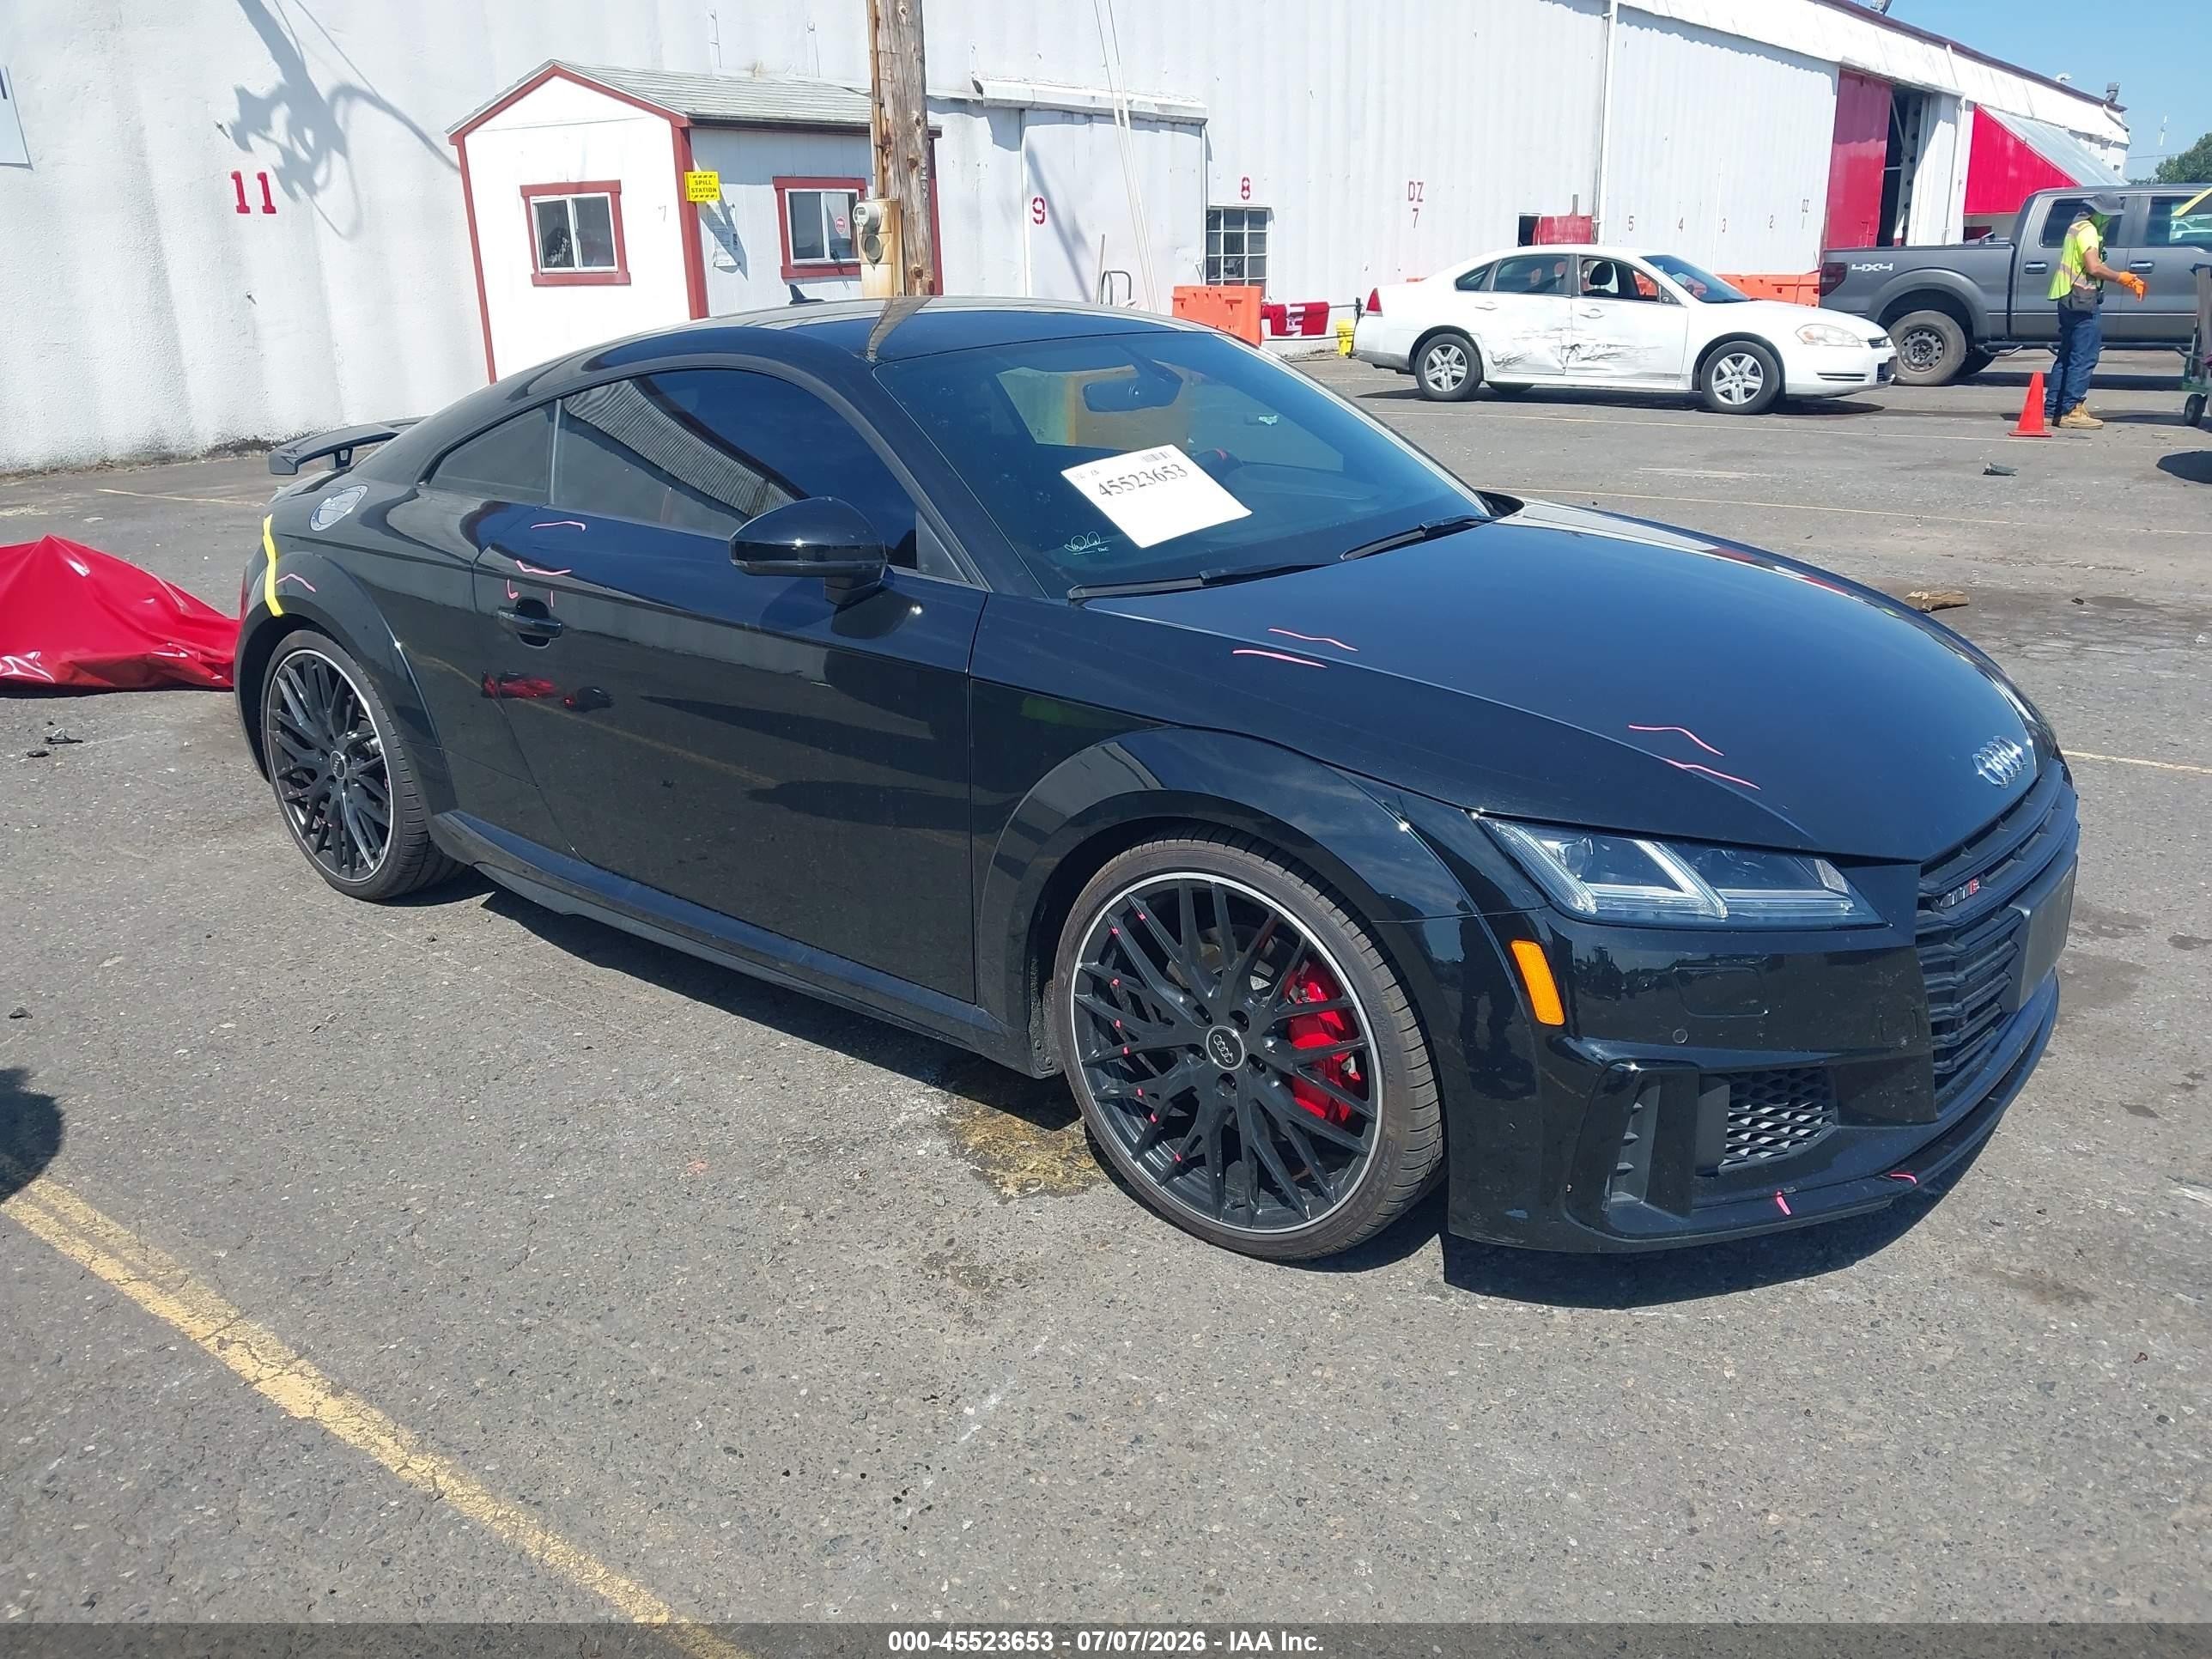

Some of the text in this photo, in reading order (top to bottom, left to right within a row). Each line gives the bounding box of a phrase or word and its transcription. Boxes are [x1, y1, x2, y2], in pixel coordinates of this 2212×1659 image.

[230, 170, 276, 214] 11
[1241, 176, 1251, 201] 8
[1032, 197, 1046, 225] 9
[1413, 208, 1419, 229] 7
[1769, 214, 1774, 228] 2
[1628, 215, 1635, 232] 5
[1678, 216, 1684, 233] 4
[1722, 218, 1727, 233] 3
[1098, 463, 1188, 496] 45523653
